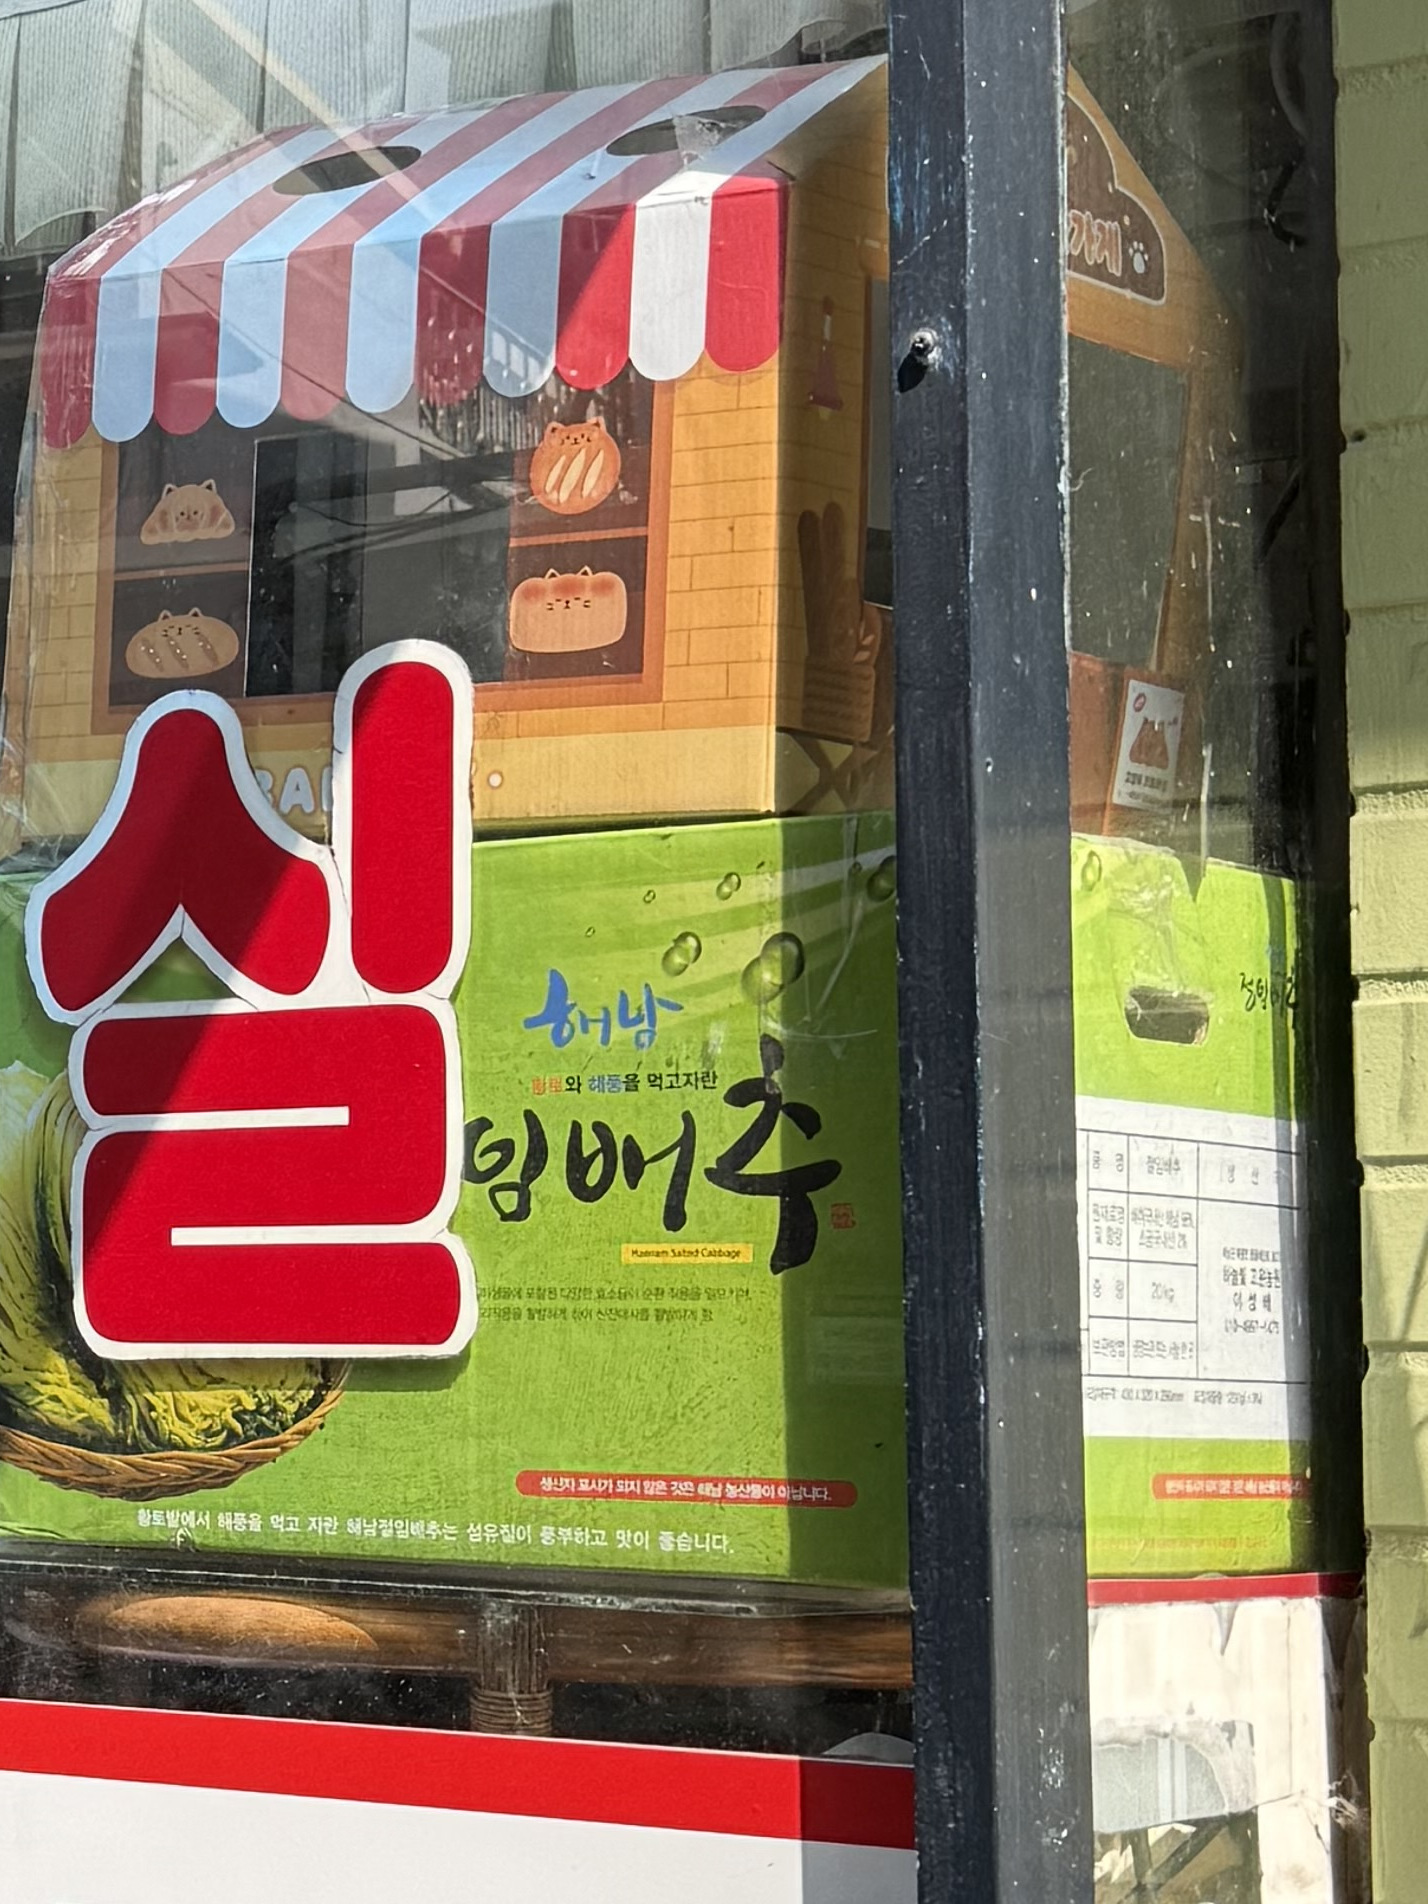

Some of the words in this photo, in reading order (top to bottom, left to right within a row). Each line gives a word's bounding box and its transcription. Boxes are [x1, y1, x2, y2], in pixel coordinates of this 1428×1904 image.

[255, 767, 332, 814] BA
[523, 968, 685, 1049] 해남
[646, 1070, 718, 1091] 먹고자란
[218, 1511, 263, 1532] 해풍을
[271, 1513, 301, 1533] 먹고
[467, 1522, 532, 1545] 섬유질이
[540, 1525, 608, 1547] 풍부하고
[616, 1529, 650, 1551] 맛이
[658, 1531, 736, 1555] 좋습니다.
